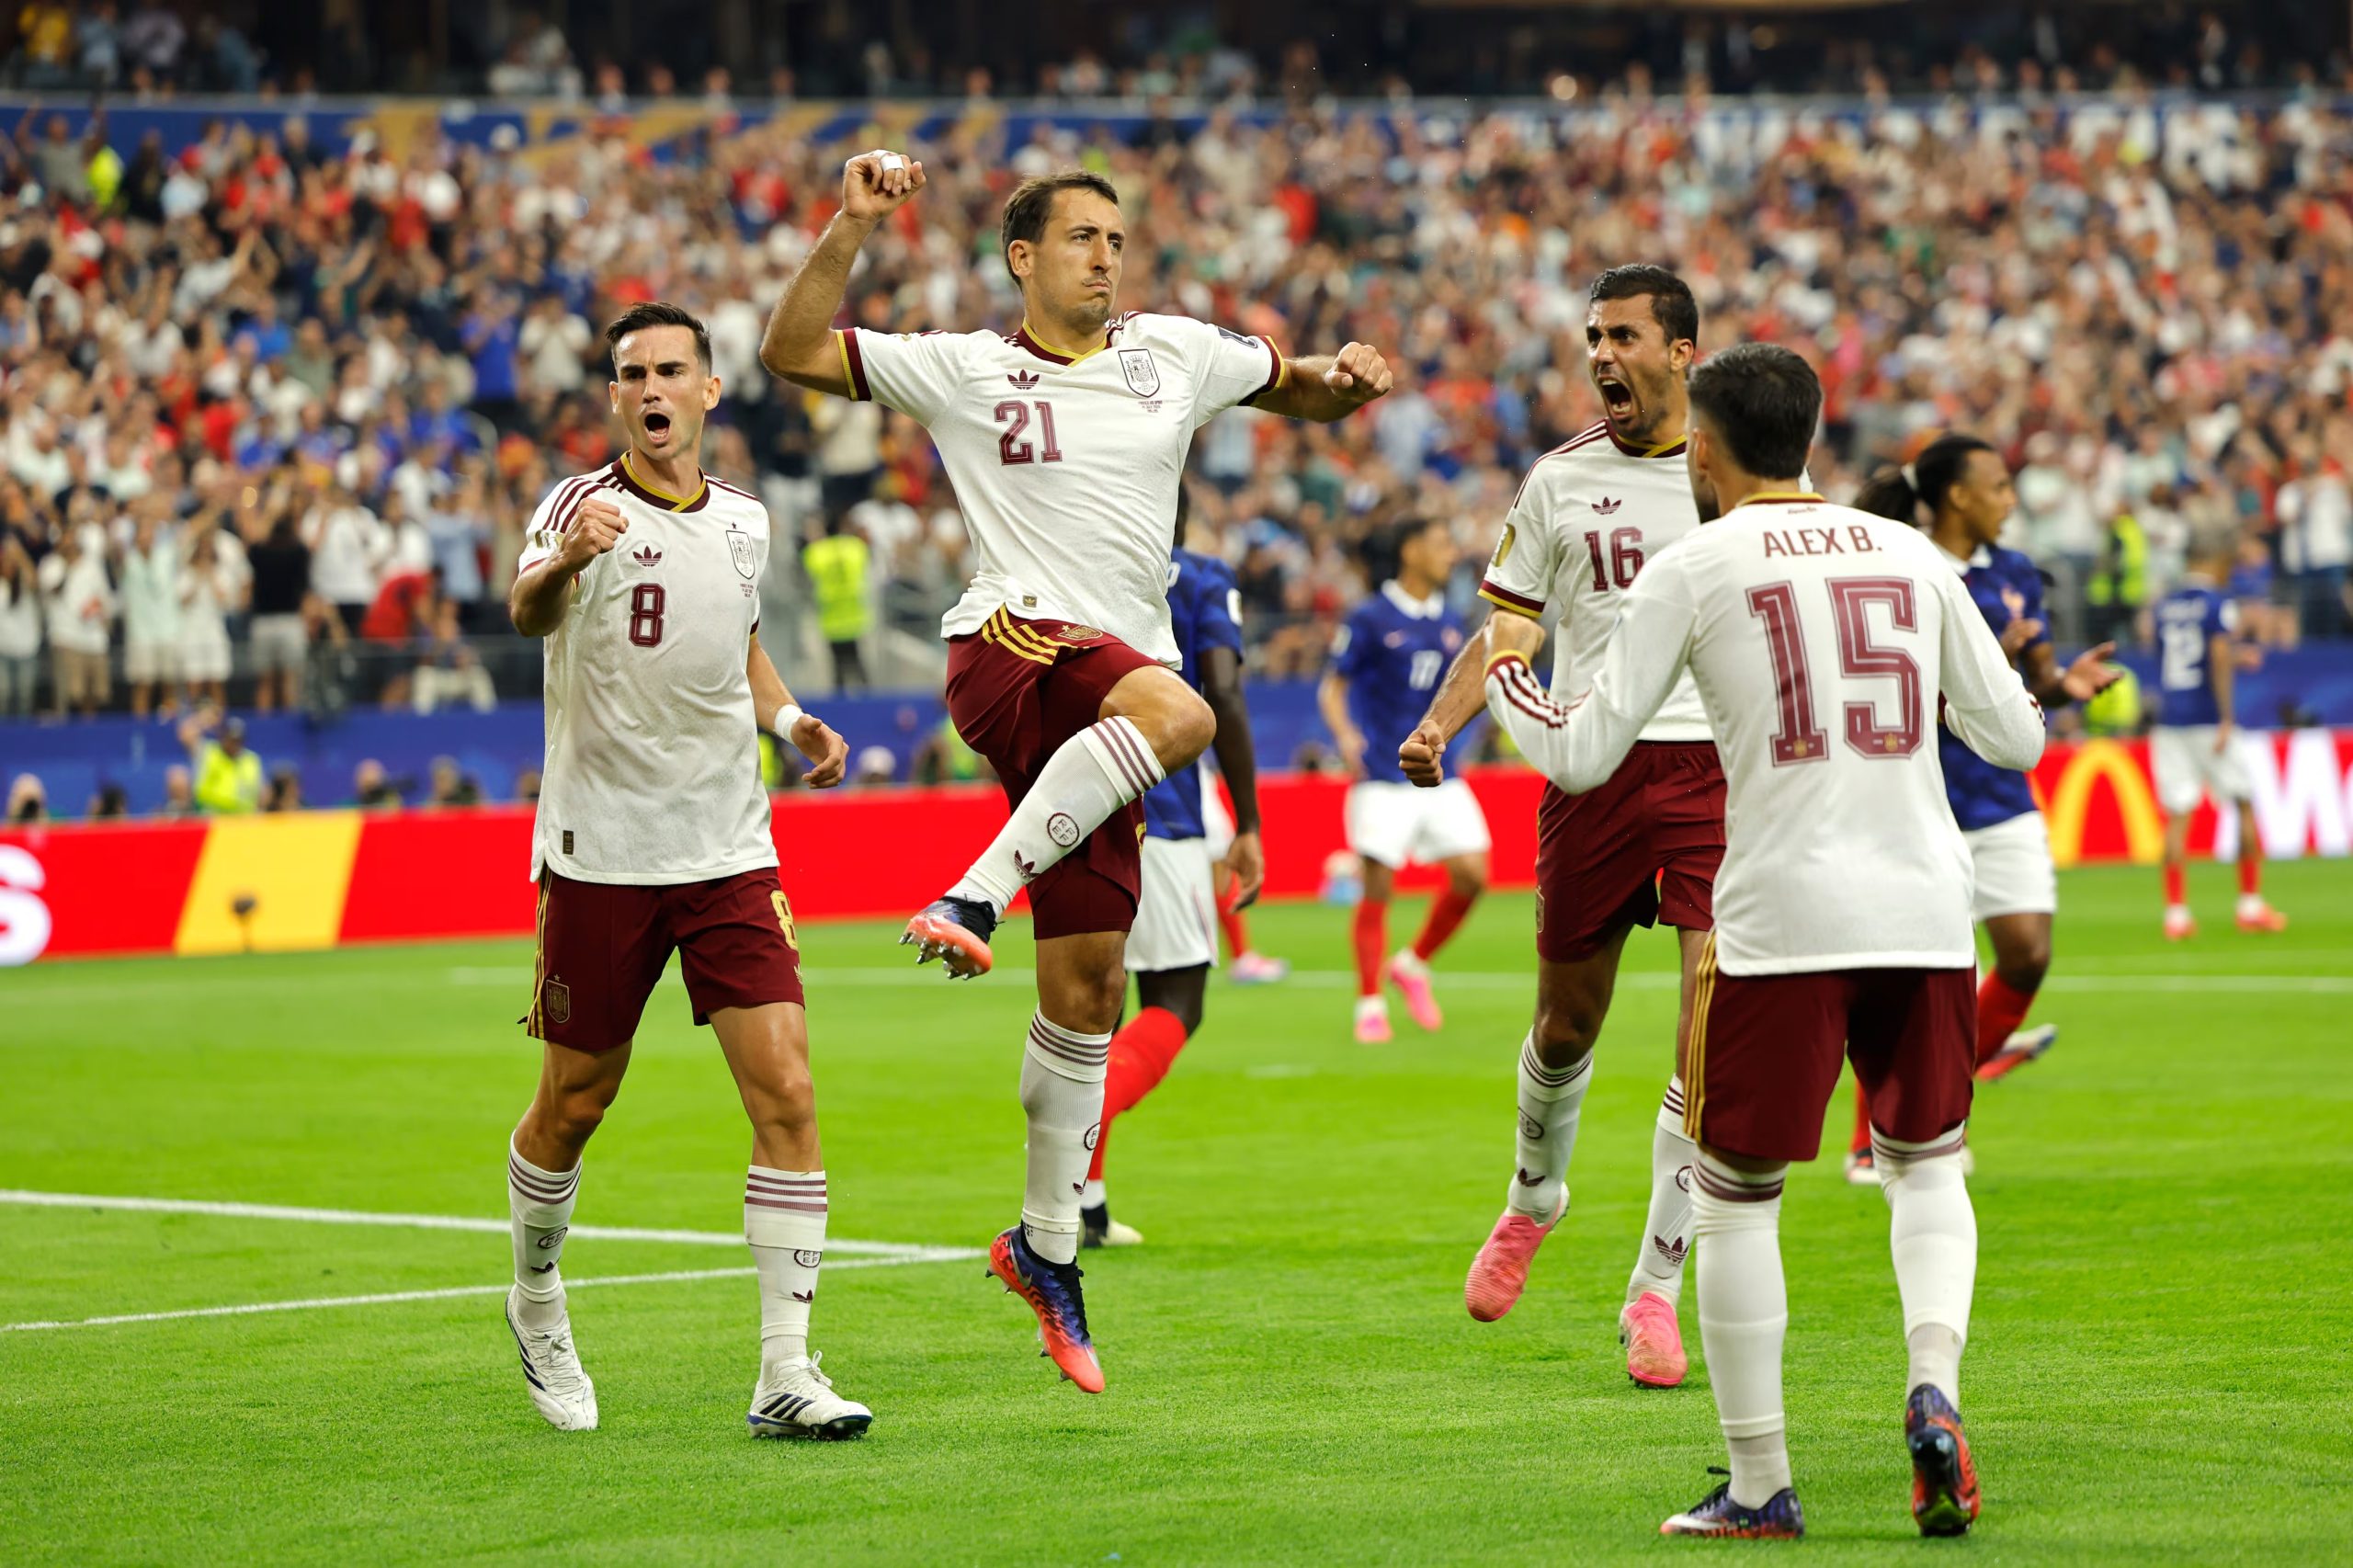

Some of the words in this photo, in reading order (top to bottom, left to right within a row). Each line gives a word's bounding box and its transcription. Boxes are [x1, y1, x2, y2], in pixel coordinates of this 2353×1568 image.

[994, 400, 1063, 466] 21
[1584, 527, 1643, 592] 16
[1763, 528, 1845, 558] ALEX
[1847, 526, 1882, 551] B.
[629, 583, 665, 648] 8
[1409, 649, 1443, 690] 17
[1745, 575, 1924, 767] 15
[770, 890, 798, 950] 8
